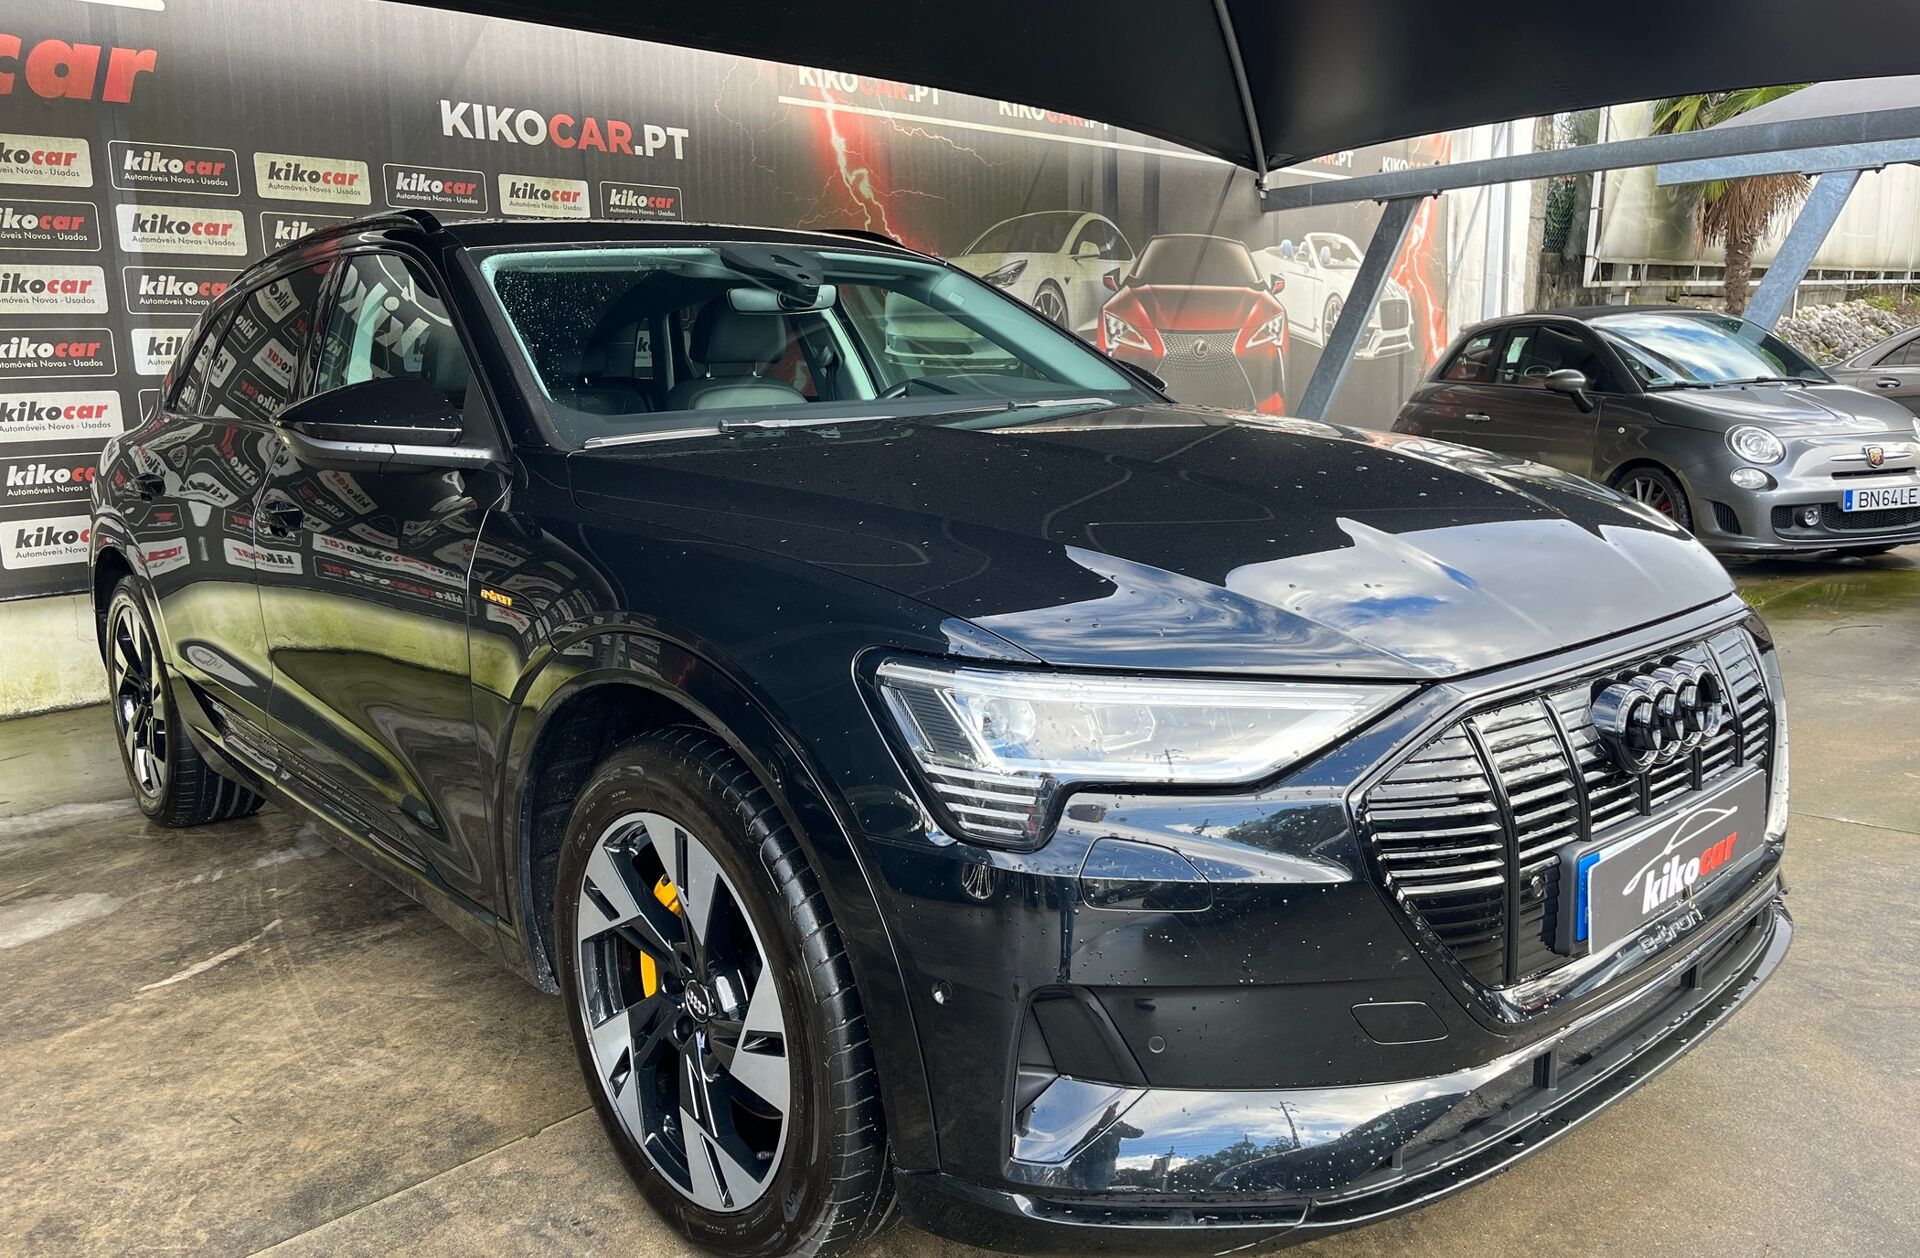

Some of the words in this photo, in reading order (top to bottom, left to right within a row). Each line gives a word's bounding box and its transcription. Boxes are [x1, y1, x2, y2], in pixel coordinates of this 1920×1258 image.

[440, 99, 689, 160] KIKOCAR.PT
[16, 166, 43, 175] Novos
[50, 168, 80, 177] Usados
[123, 150, 226, 176] kikocar
[124, 173, 168, 182] Automóveis
[170, 176, 195, 184] Novos
[201, 177, 229, 186] Usados
[268, 161, 359, 186] kikocar
[395, 171, 477, 195] kikocar
[268, 183, 308, 192] Automóveis
[336, 188, 361, 196] Usados
[509, 182, 581, 203] kikocar
[609, 188, 675, 209] kikocar
[456, 196, 479, 204] Usados
[132, 213, 233, 237] kikocar
[24, 231, 51, 240] Novos
[57, 232, 88, 241] Usados
[132, 235, 175, 244] Automóveis
[177, 237, 202, 245] Novos
[208, 238, 236, 247] Usados
[0, 272, 93, 294] ikocar
[139, 275, 228, 297] kikoca
[32, 296, 59, 304] Novos
[65, 296, 95, 304] Usados
[139, 297, 183, 305] Automóveis
[185, 298, 210, 306] Novos
[40, 360, 67, 368] Novos
[73, 359, 104, 367] Usados
[0, 401, 109, 423] kikocar
[82, 420, 111, 429] Usados
[6, 487, 55, 497] Automóveis
[56, 485, 83, 493] Novos
[1859, 488, 1918, 508] BN64LE
[15, 526, 90, 549] kikoc
[15, 549, 63, 559] Automóveis
[65, 546, 88, 554] Novo
[1641, 832, 1738, 915] kikocar
